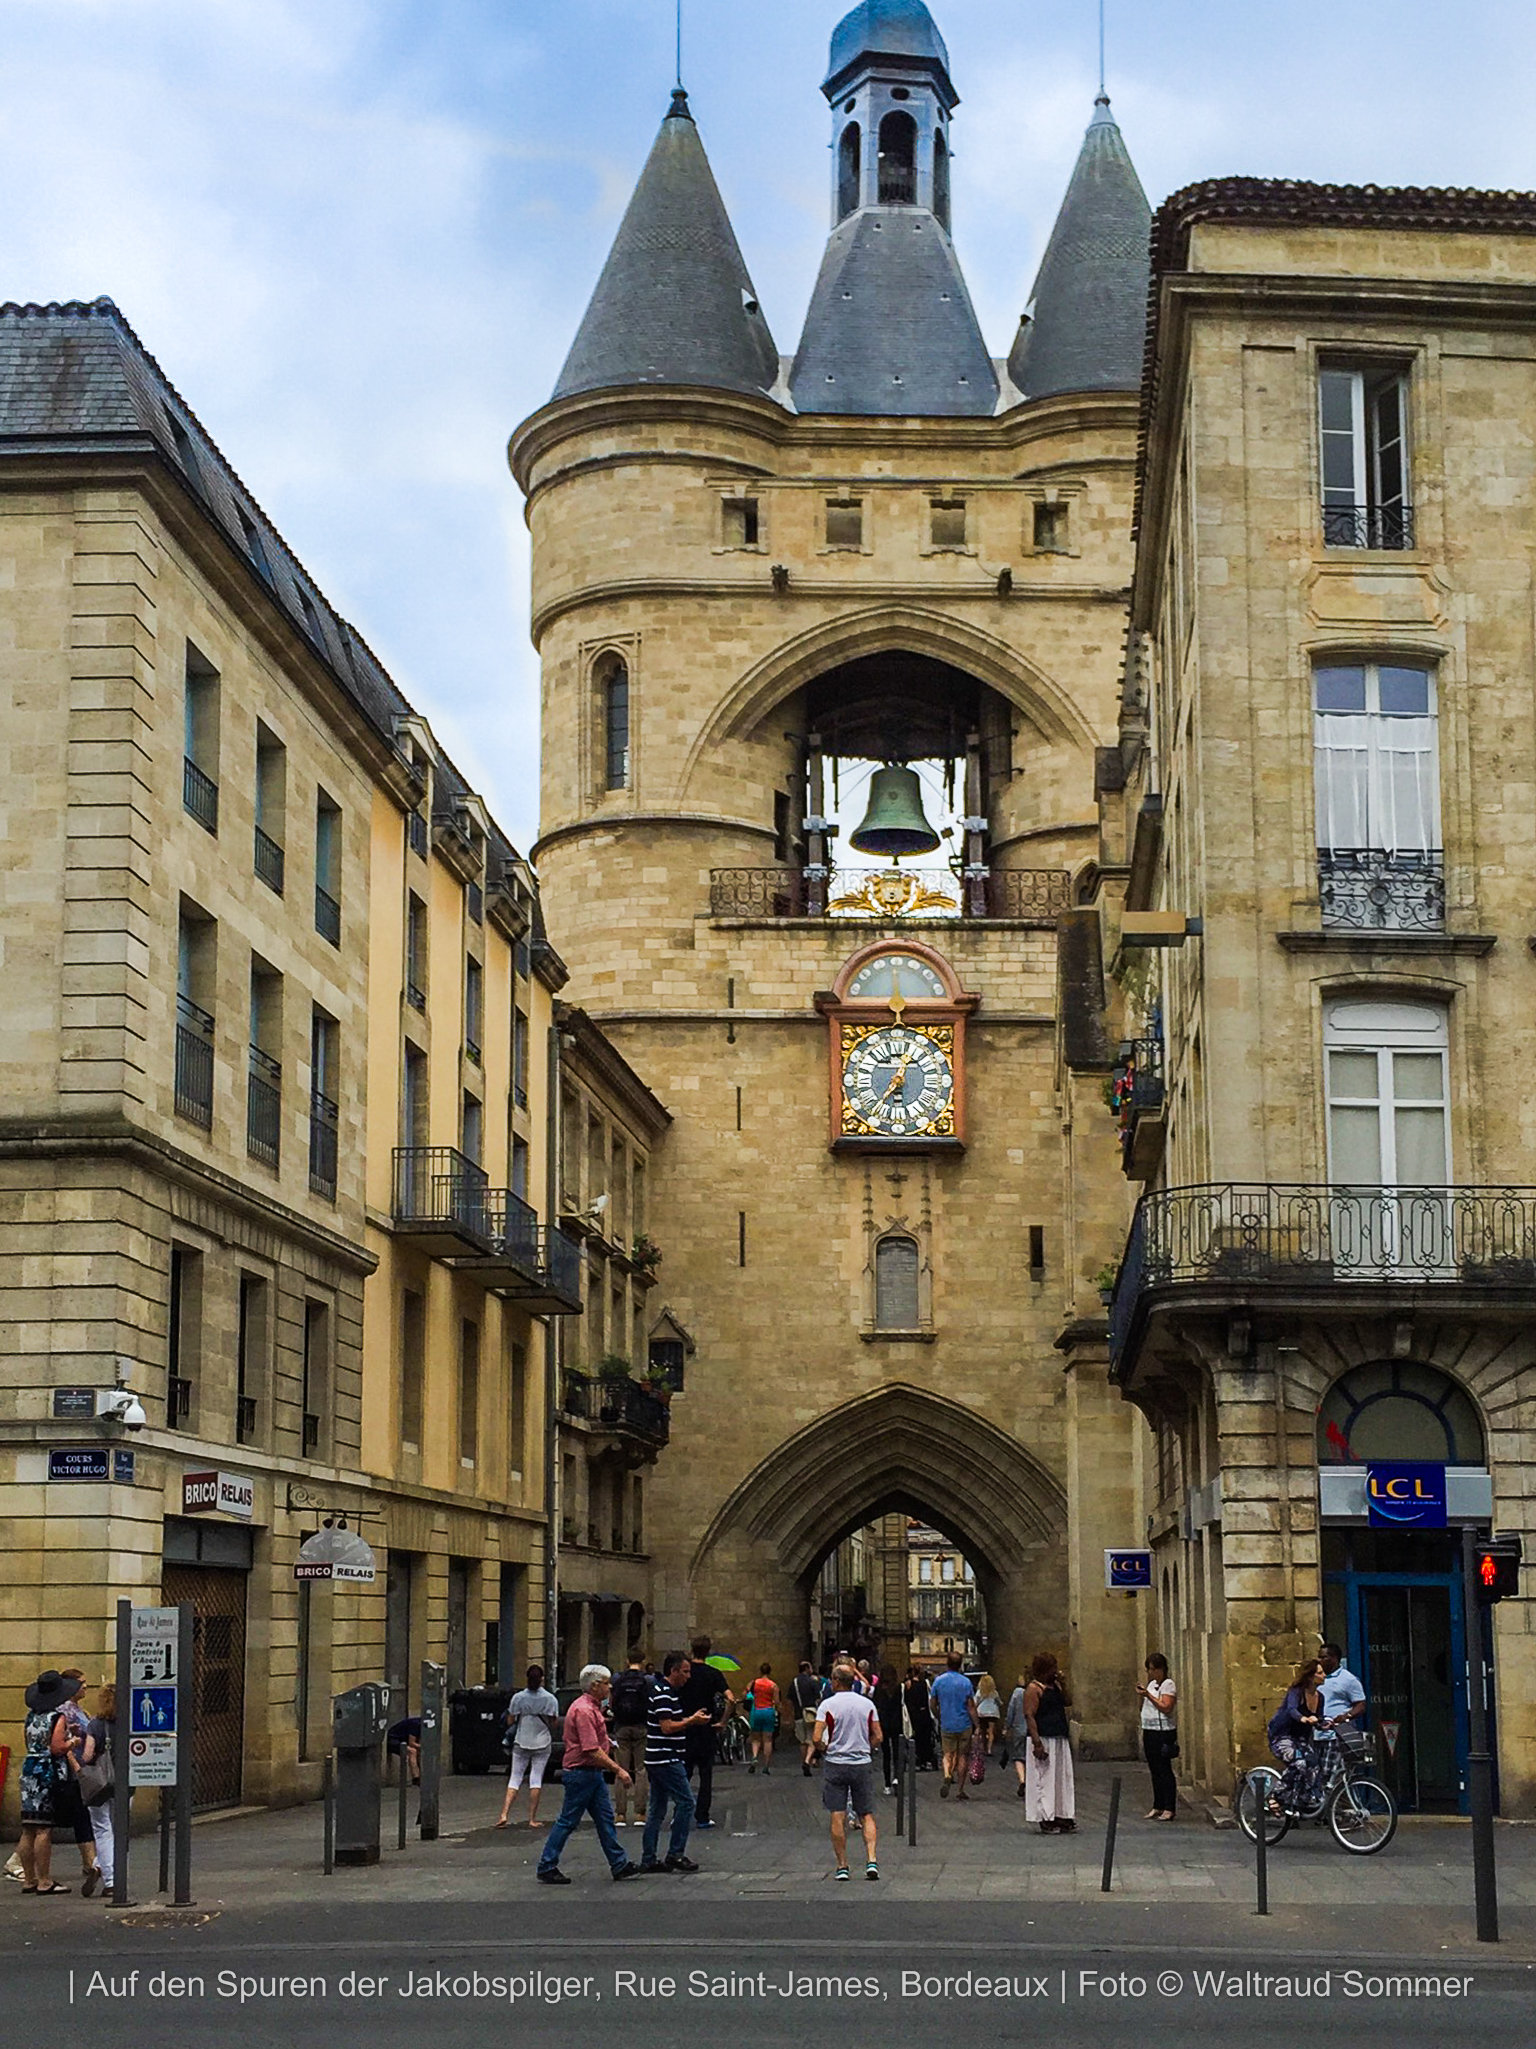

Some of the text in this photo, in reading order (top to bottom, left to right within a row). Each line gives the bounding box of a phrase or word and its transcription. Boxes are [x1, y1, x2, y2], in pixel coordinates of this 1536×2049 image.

[65, 1455, 93, 1464] COURS
[52, 1465, 82, 1474] VICTOR
[82, 1465, 106, 1474] HUGO
[185, 1482, 253, 1507] BRICO RELAIS
[1370, 1478, 1435, 1499] LCL
[1113, 1560, 1146, 1572] LCL
[296, 1567, 374, 1579] BRICO RELAIS
[134, 1640, 153, 1648] Zone
